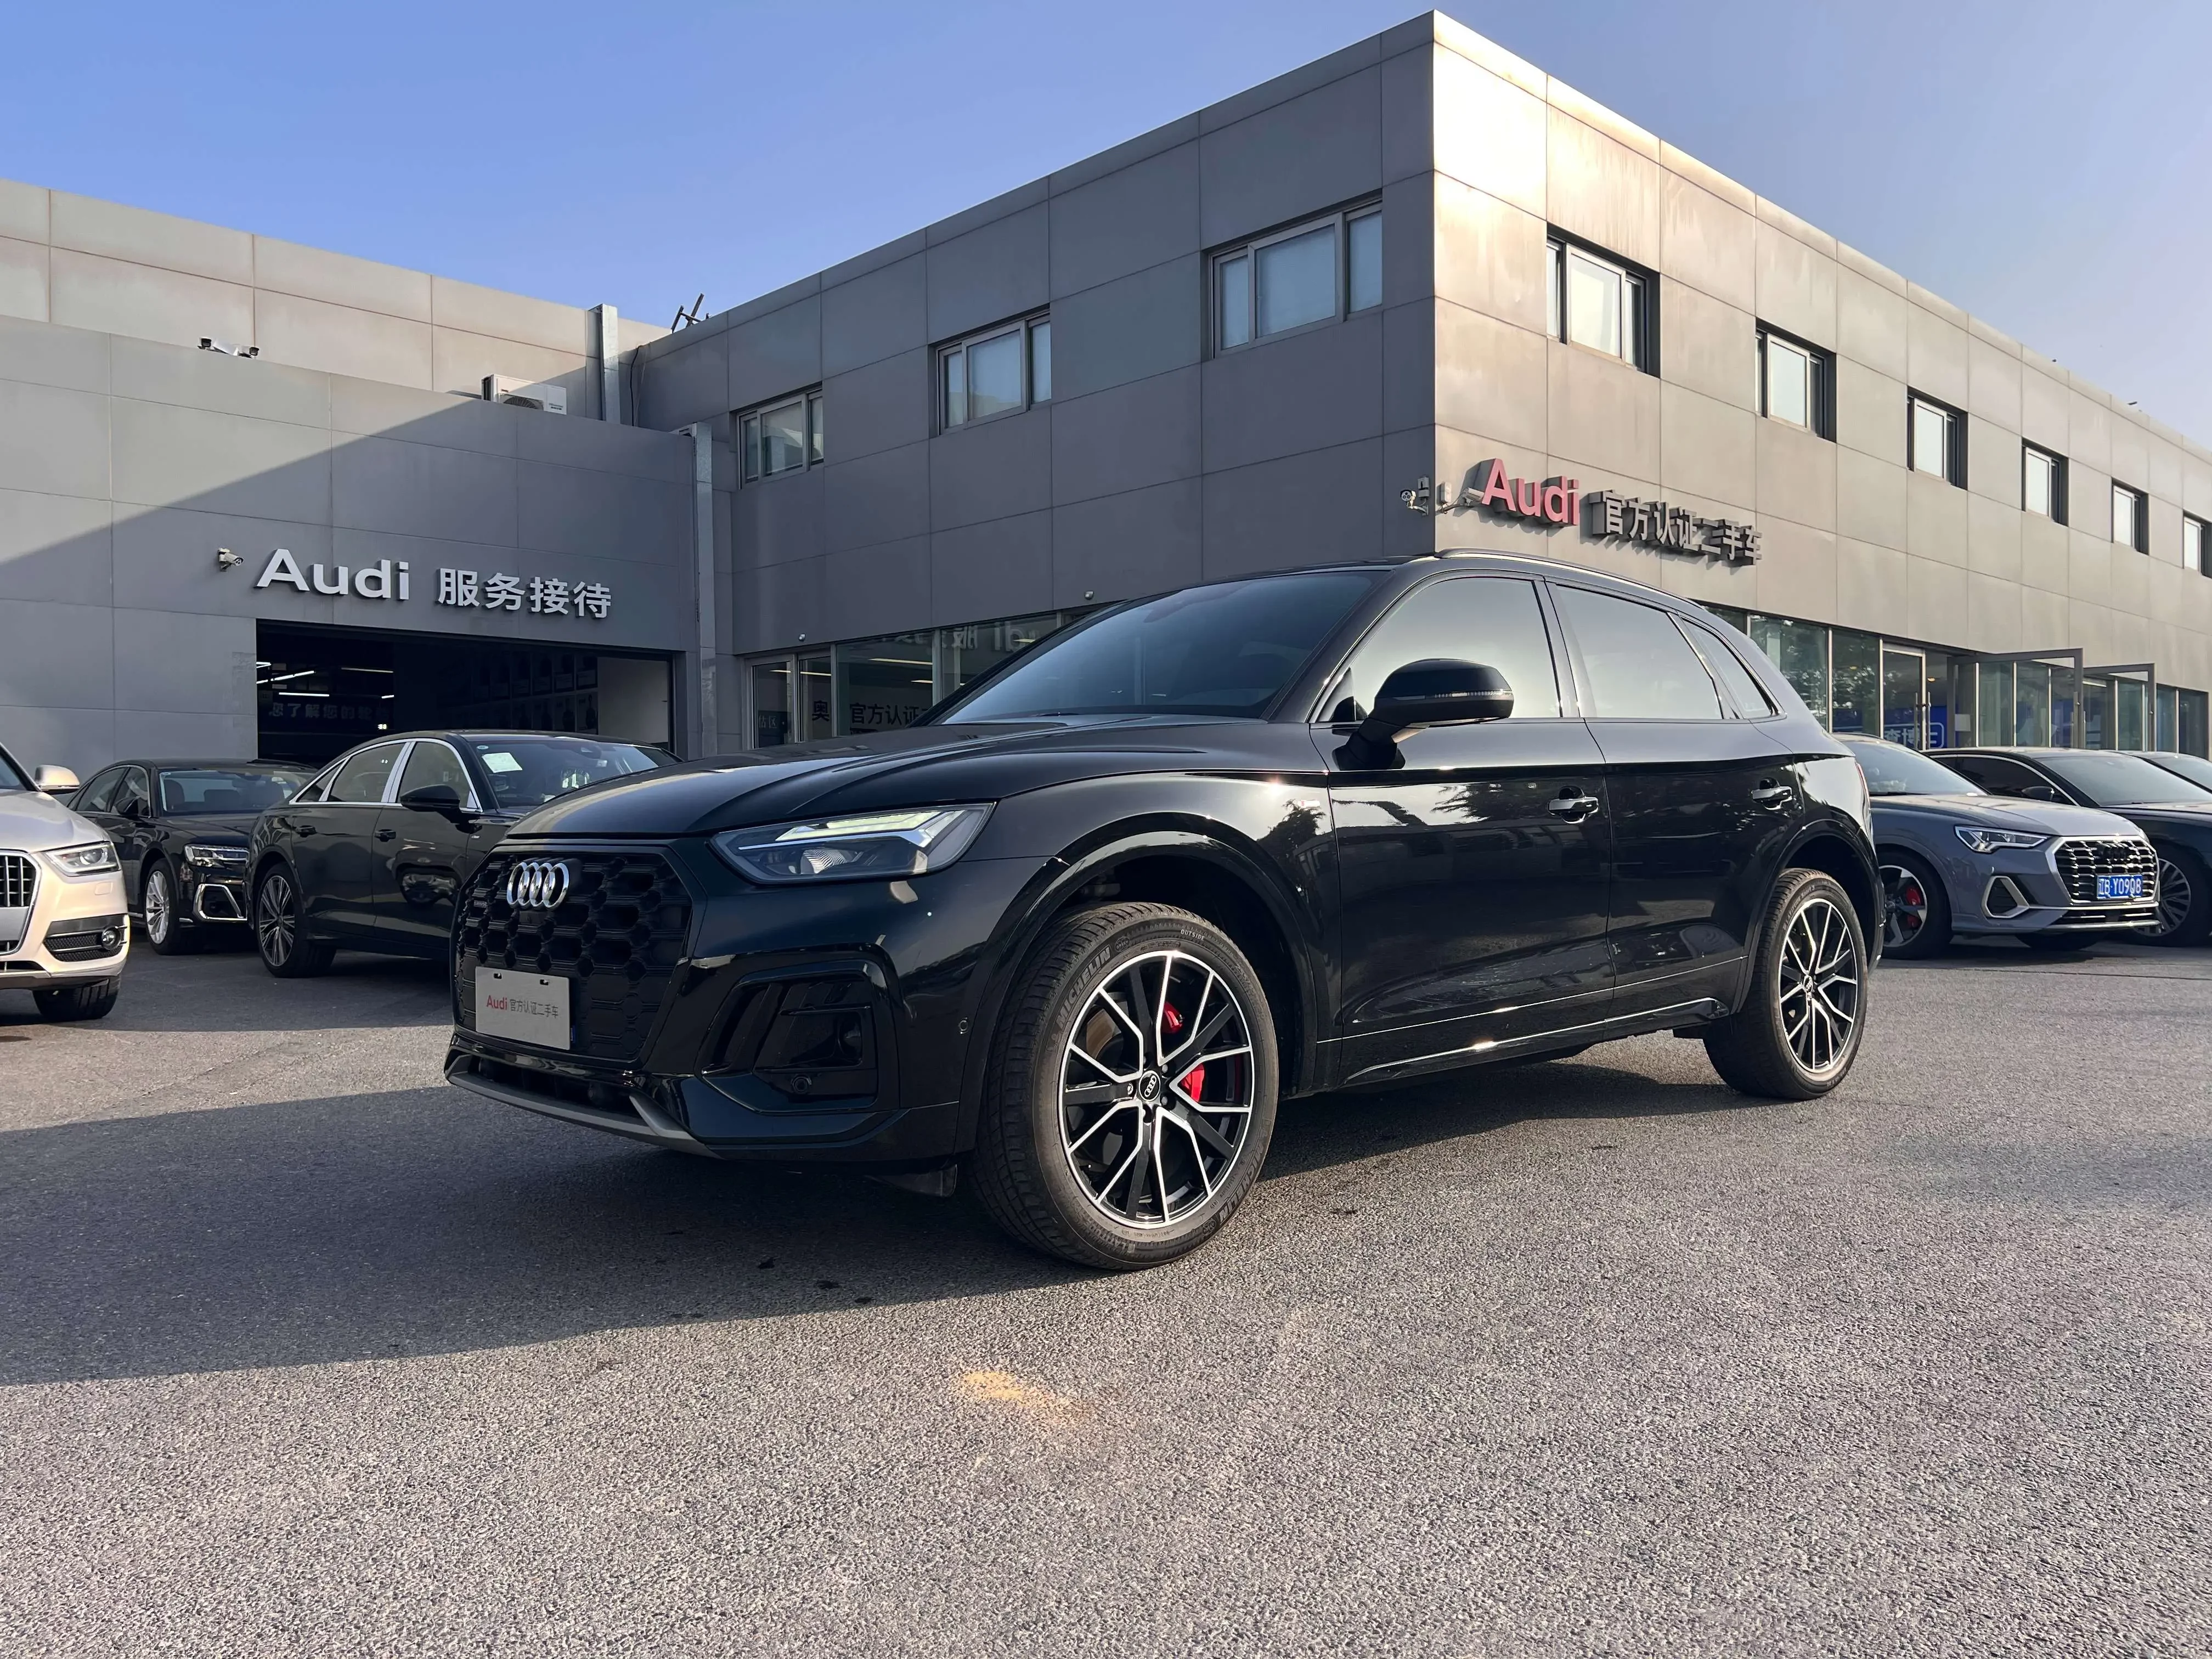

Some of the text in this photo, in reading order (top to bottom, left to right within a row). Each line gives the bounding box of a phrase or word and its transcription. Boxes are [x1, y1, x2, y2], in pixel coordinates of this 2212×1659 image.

[1482, 458, 1763, 565] Audi 官方认证二手车
[255, 549, 612, 619] Audi 服务接待
[1181, 929, 1205, 941] OUTSIDE
[487, 995, 558, 1019] Audi 官方认证二手车
[1057, 946, 1111, 1030] MICHELIN
[1220, 1143, 1264, 1222] MICHELIN
